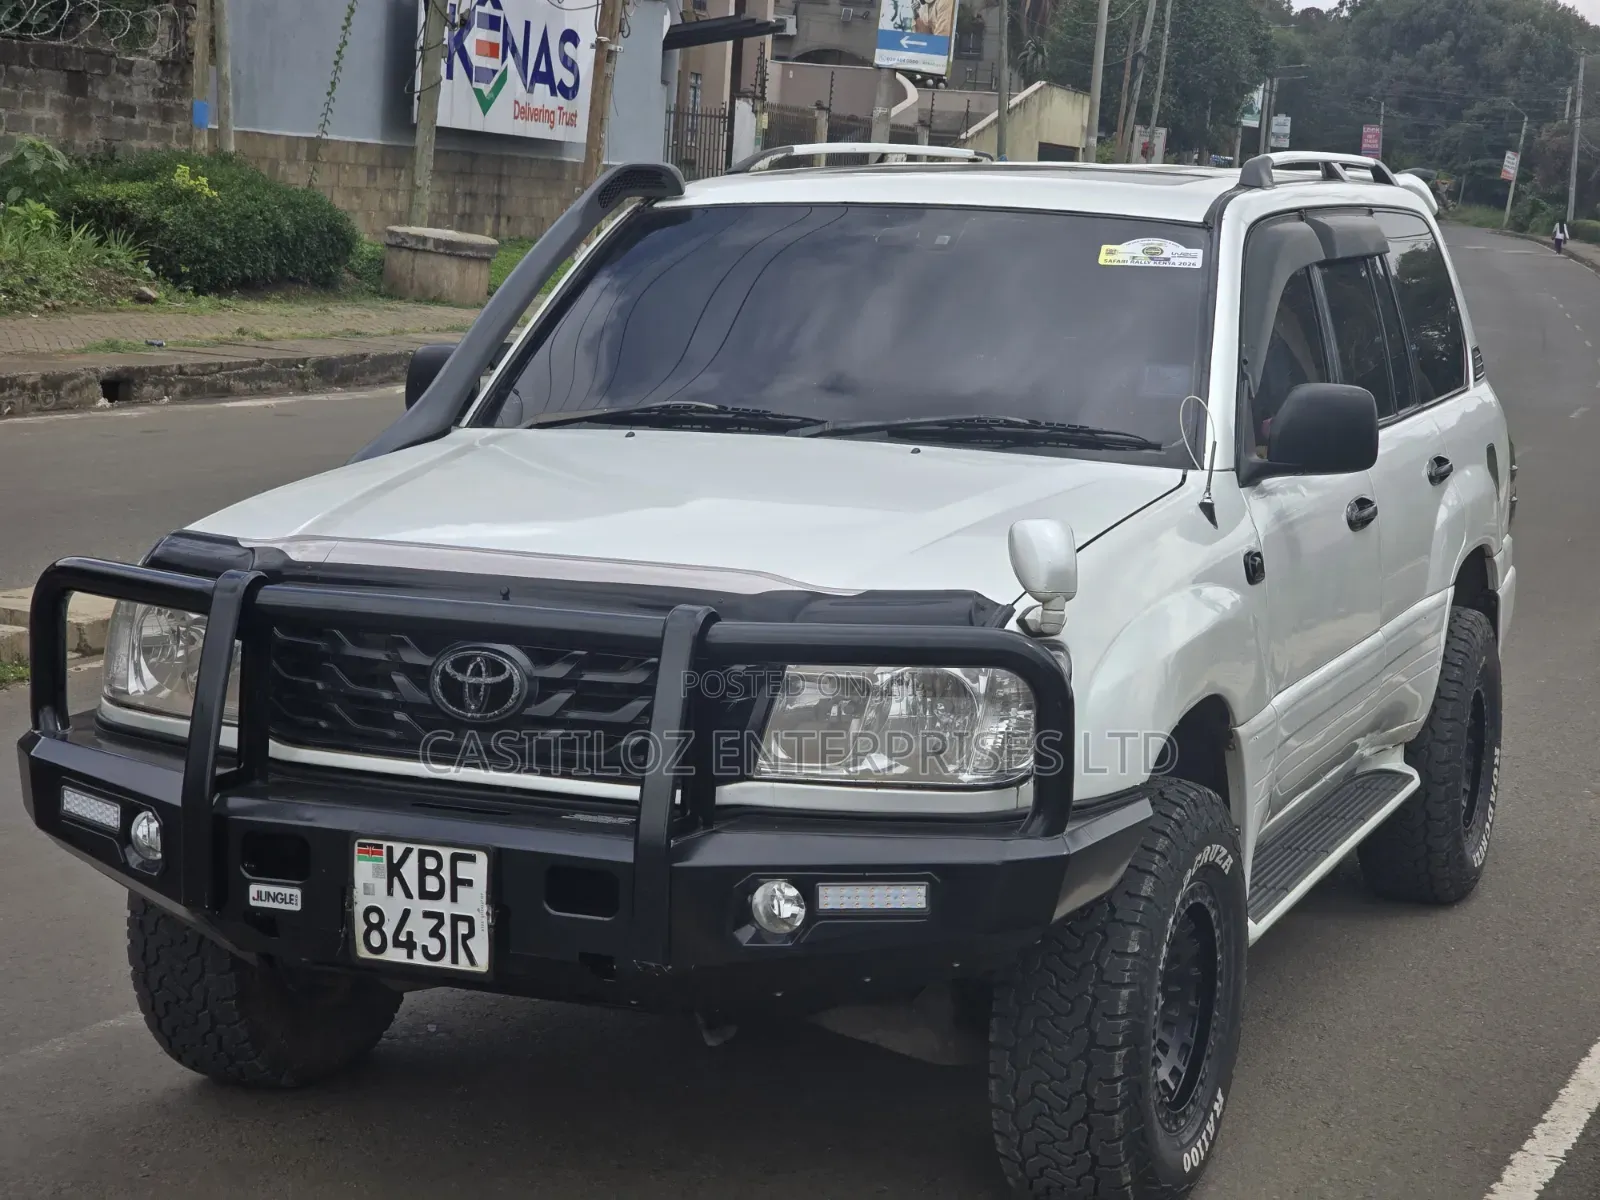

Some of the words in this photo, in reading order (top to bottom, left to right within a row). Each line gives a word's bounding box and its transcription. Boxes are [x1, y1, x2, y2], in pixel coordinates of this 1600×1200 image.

[513, 99, 556, 130] Delivering
[557, 105, 578, 128] Trust
[385, 845, 478, 904] KBF
[251, 889, 295, 906] JUNGLE
[362, 904, 479, 967] 843R
